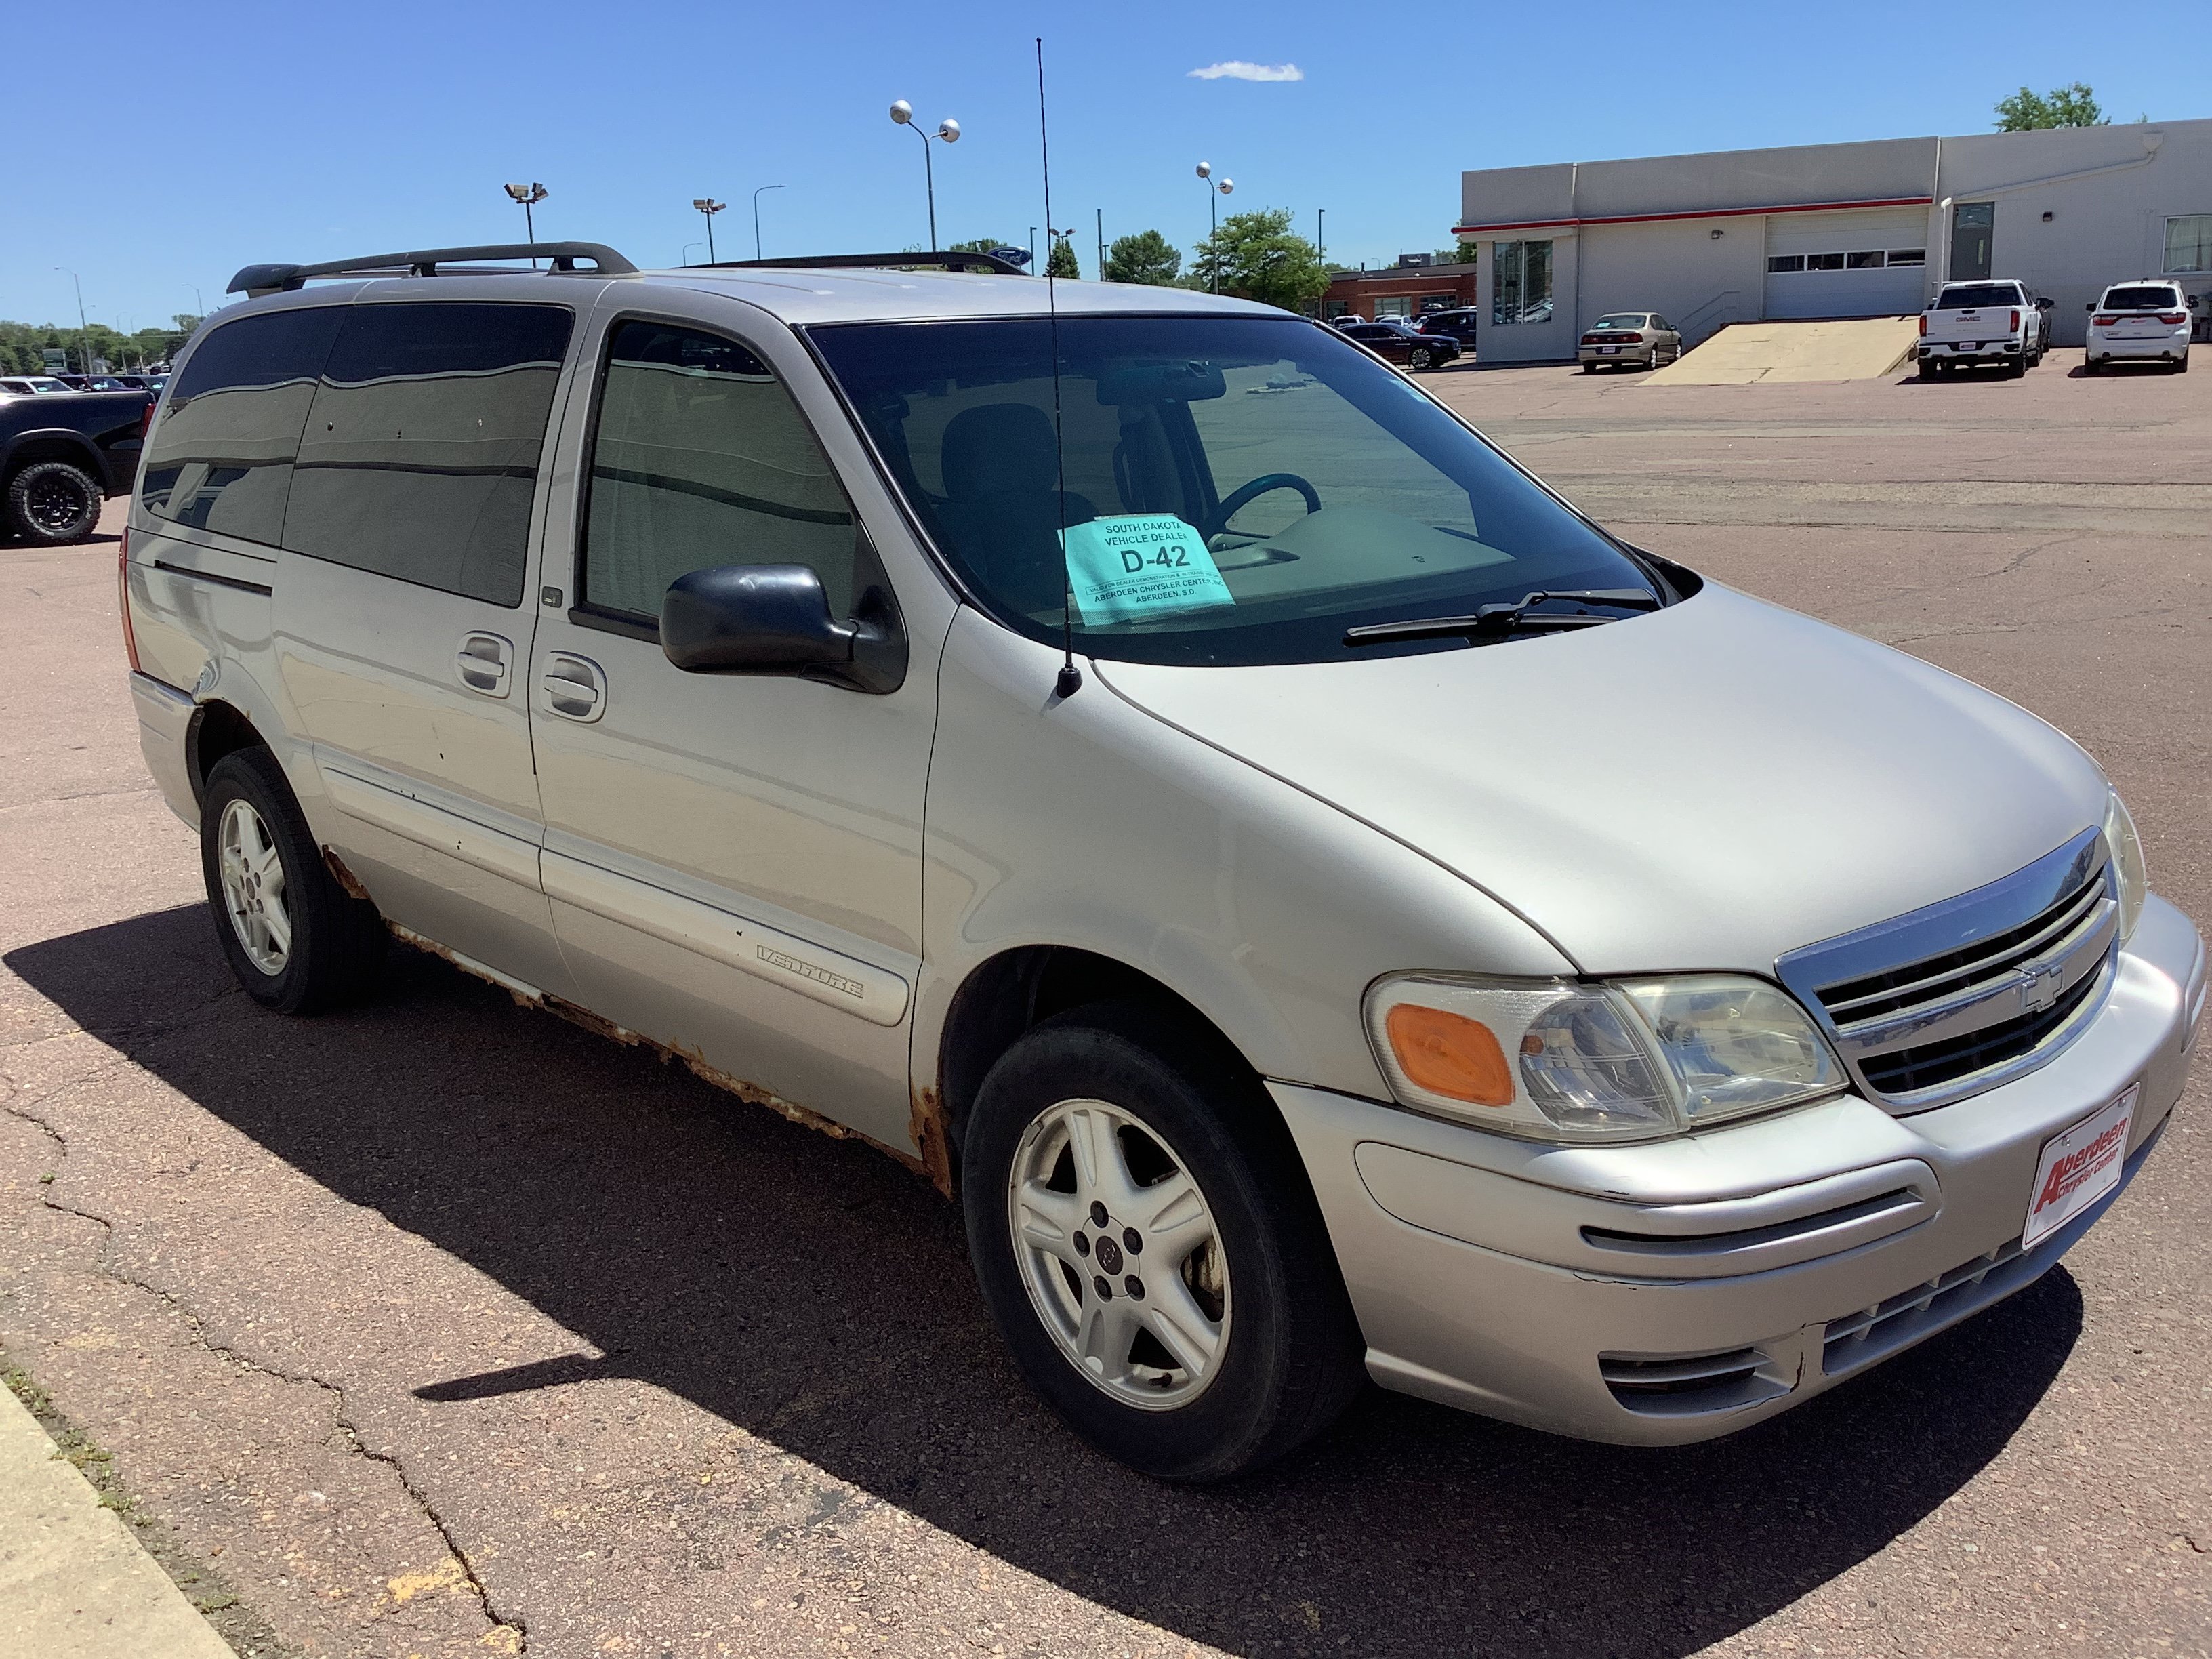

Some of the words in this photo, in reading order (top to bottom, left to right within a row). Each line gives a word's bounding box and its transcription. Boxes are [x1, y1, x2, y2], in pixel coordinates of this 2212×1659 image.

[998, 251, 1022, 263] Ford
[1106, 523, 1141, 533] SOUTH
[1143, 522, 1182, 530] DAKOTA
[1105, 535, 1149, 546] VEHICLE
[1120, 545, 1191, 573] D-42
[1136, 573, 1176, 582] DEMONSTRATION
[1094, 588, 1138, 602] ABERDEEN
[1139, 581, 1181, 593] CHRYSLER
[1182, 578, 1212, 586] CENTER,
[1136, 590, 1181, 603] ABERDEEN,
[757, 945, 864, 999] VENTURE
[2034, 1117, 2128, 1214] Aberdeen
[2057, 1166, 2094, 1199] Chrysler
